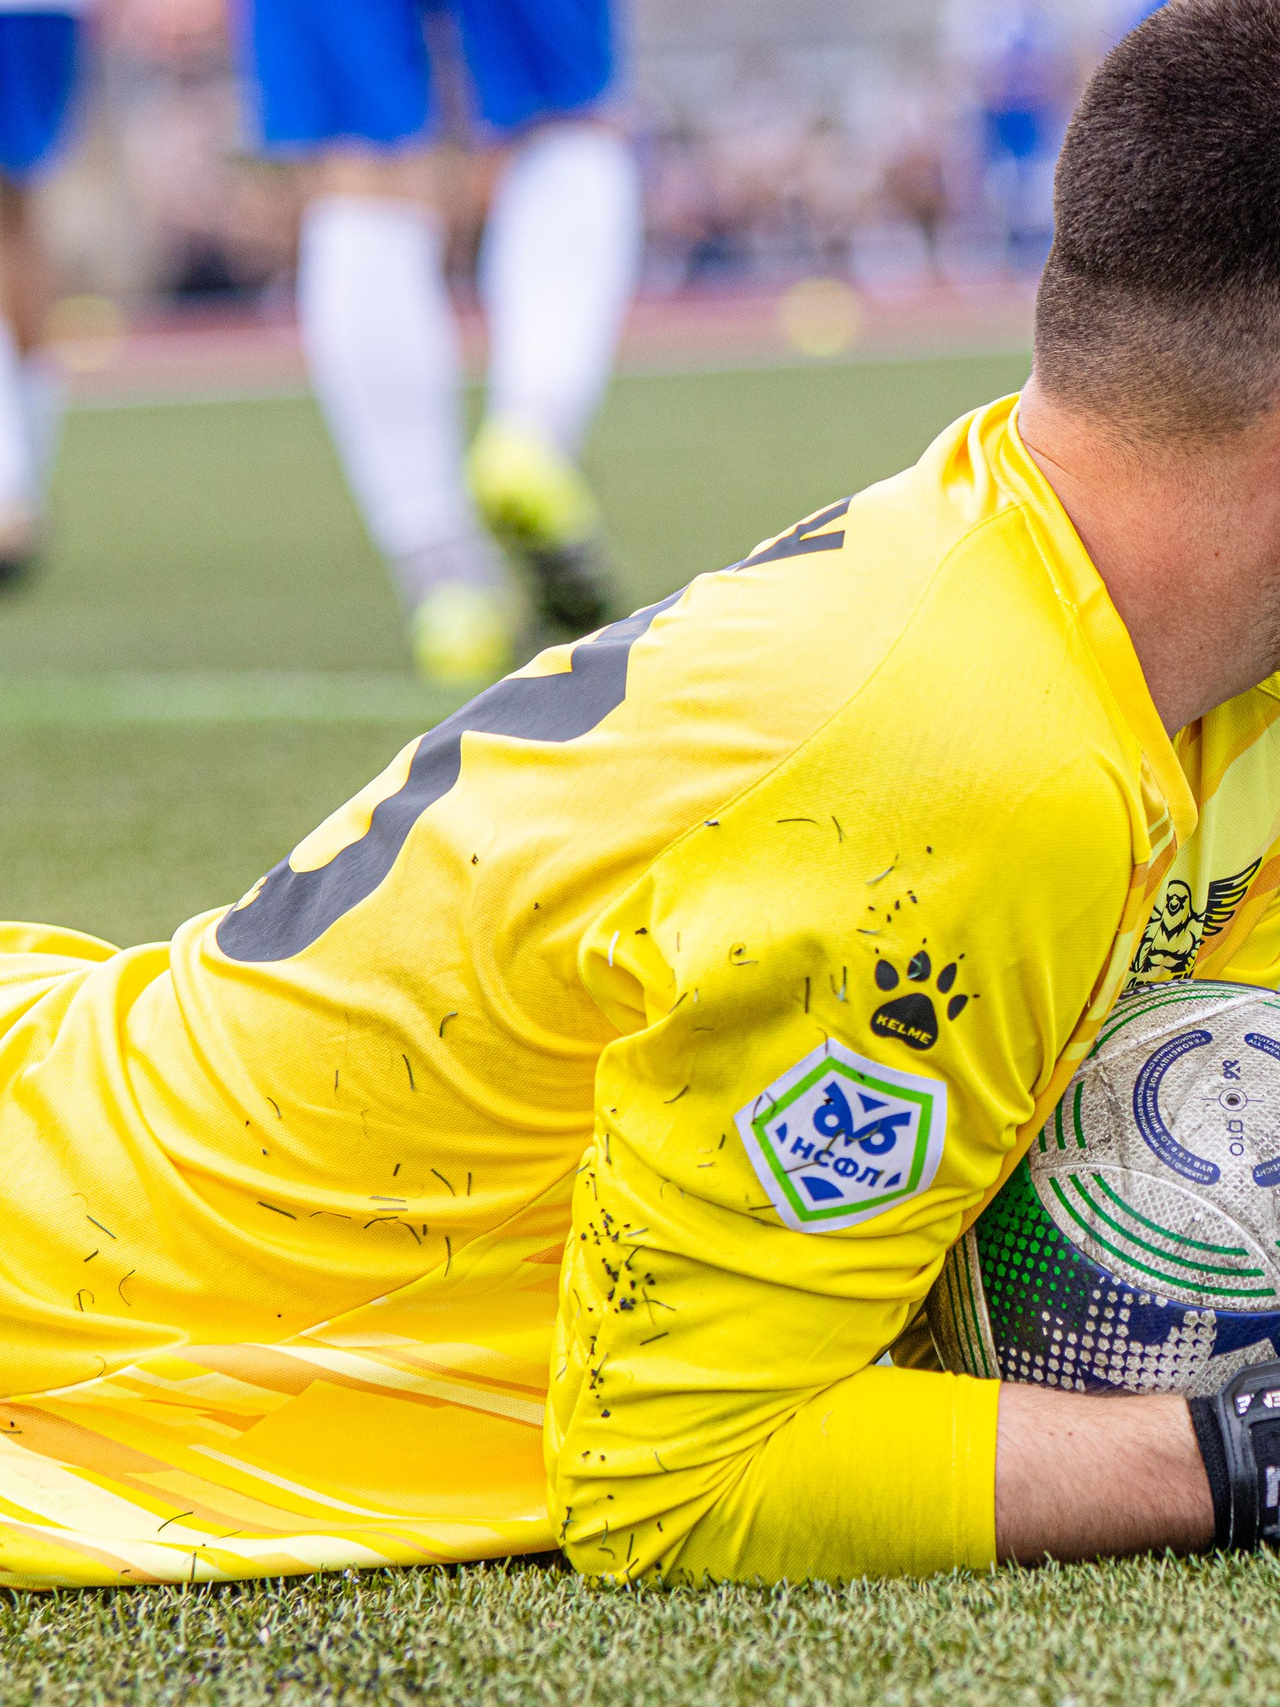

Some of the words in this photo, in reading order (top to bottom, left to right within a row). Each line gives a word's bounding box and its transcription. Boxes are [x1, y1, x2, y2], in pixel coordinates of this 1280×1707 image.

[876, 1014, 932, 1045] KELME
[1248, 1039, 1262, 1047] ALL
[1146, 1090, 1163, 1134] ДАВЛЕНИЕ
[790, 1136, 885, 1188] НСФЛ
